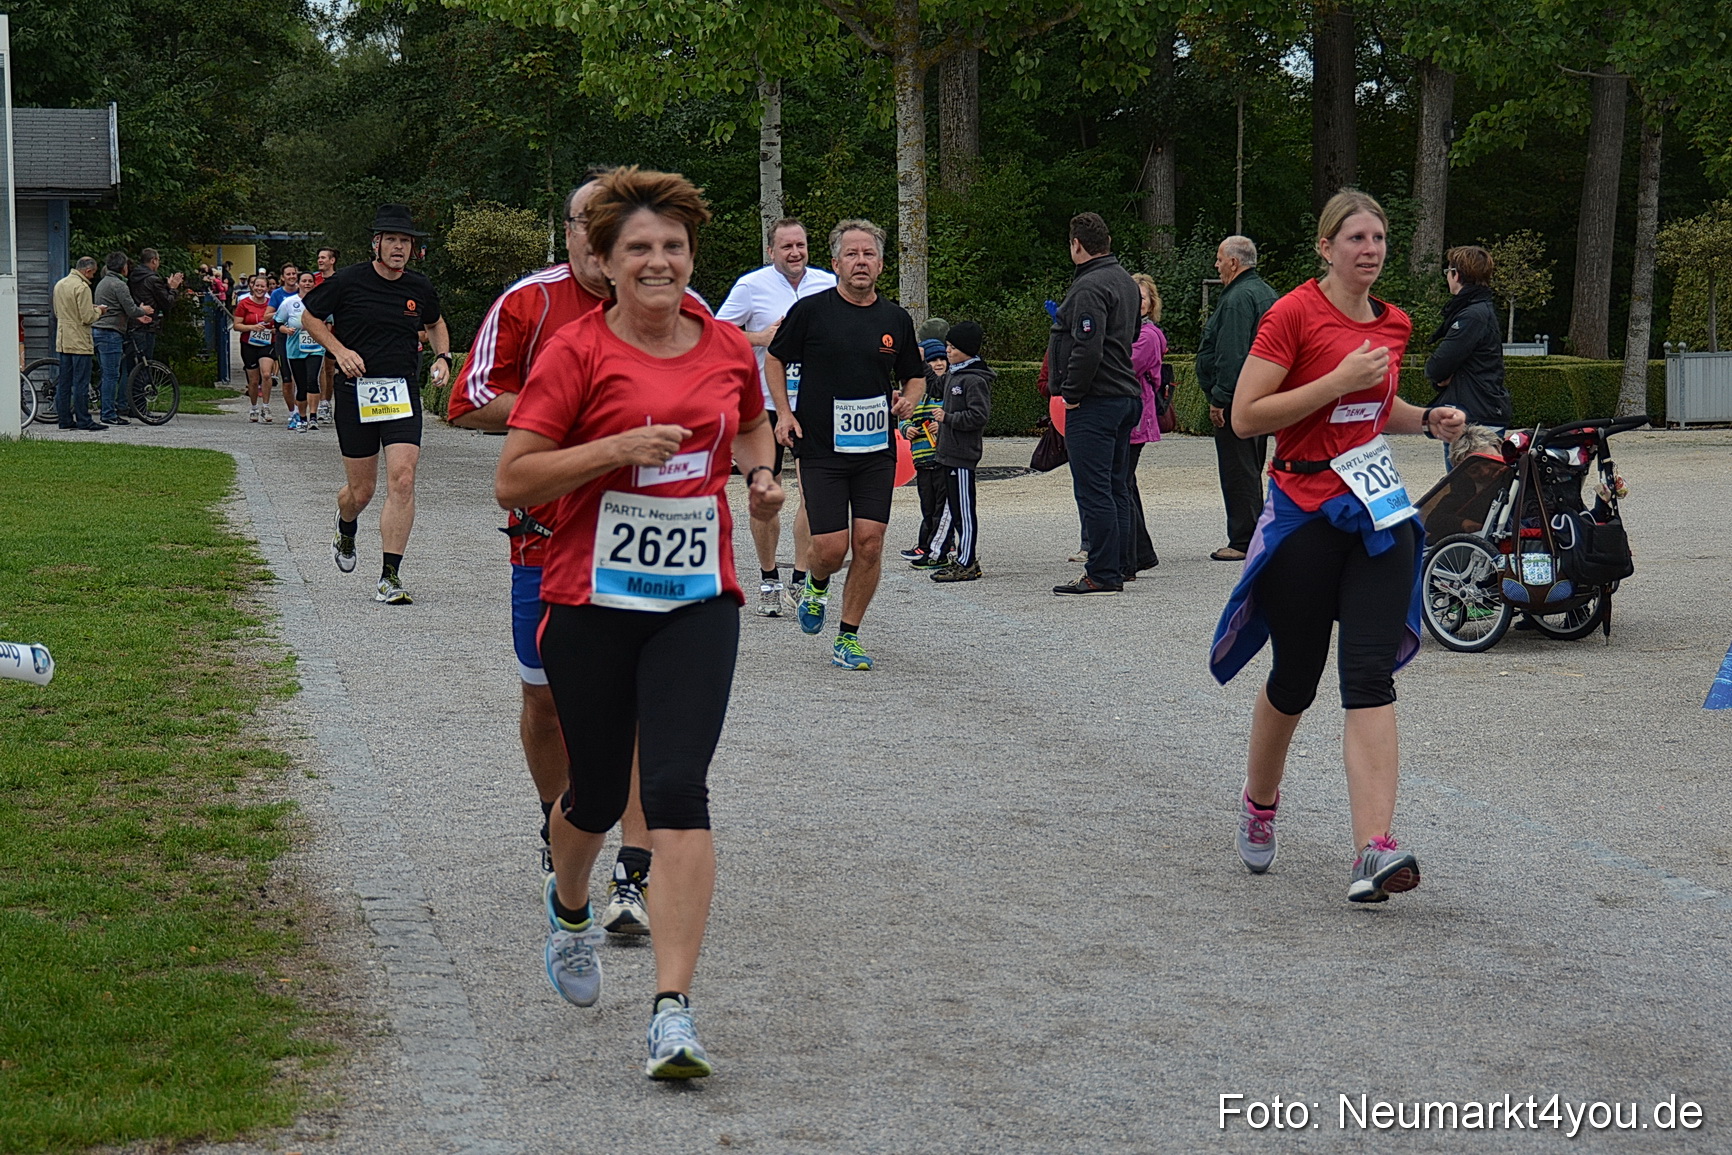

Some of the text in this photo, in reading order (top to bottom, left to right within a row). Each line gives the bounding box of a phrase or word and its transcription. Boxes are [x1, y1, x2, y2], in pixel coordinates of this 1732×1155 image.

[368, 386, 398, 404] 231
[371, 407, 400, 415] Matthias
[857, 402, 882, 411] Neumarkt
[1345, 407, 1366, 417] DEHN
[840, 410, 885, 432] 3000
[658, 461, 689, 476] DEHN
[1336, 456, 1364, 474] PARTL
[1352, 455, 1400, 497] 203
[604, 502, 702, 521] PARTL Neumarkt
[609, 522, 708, 568] 2625
[627, 576, 686, 597] Monika
